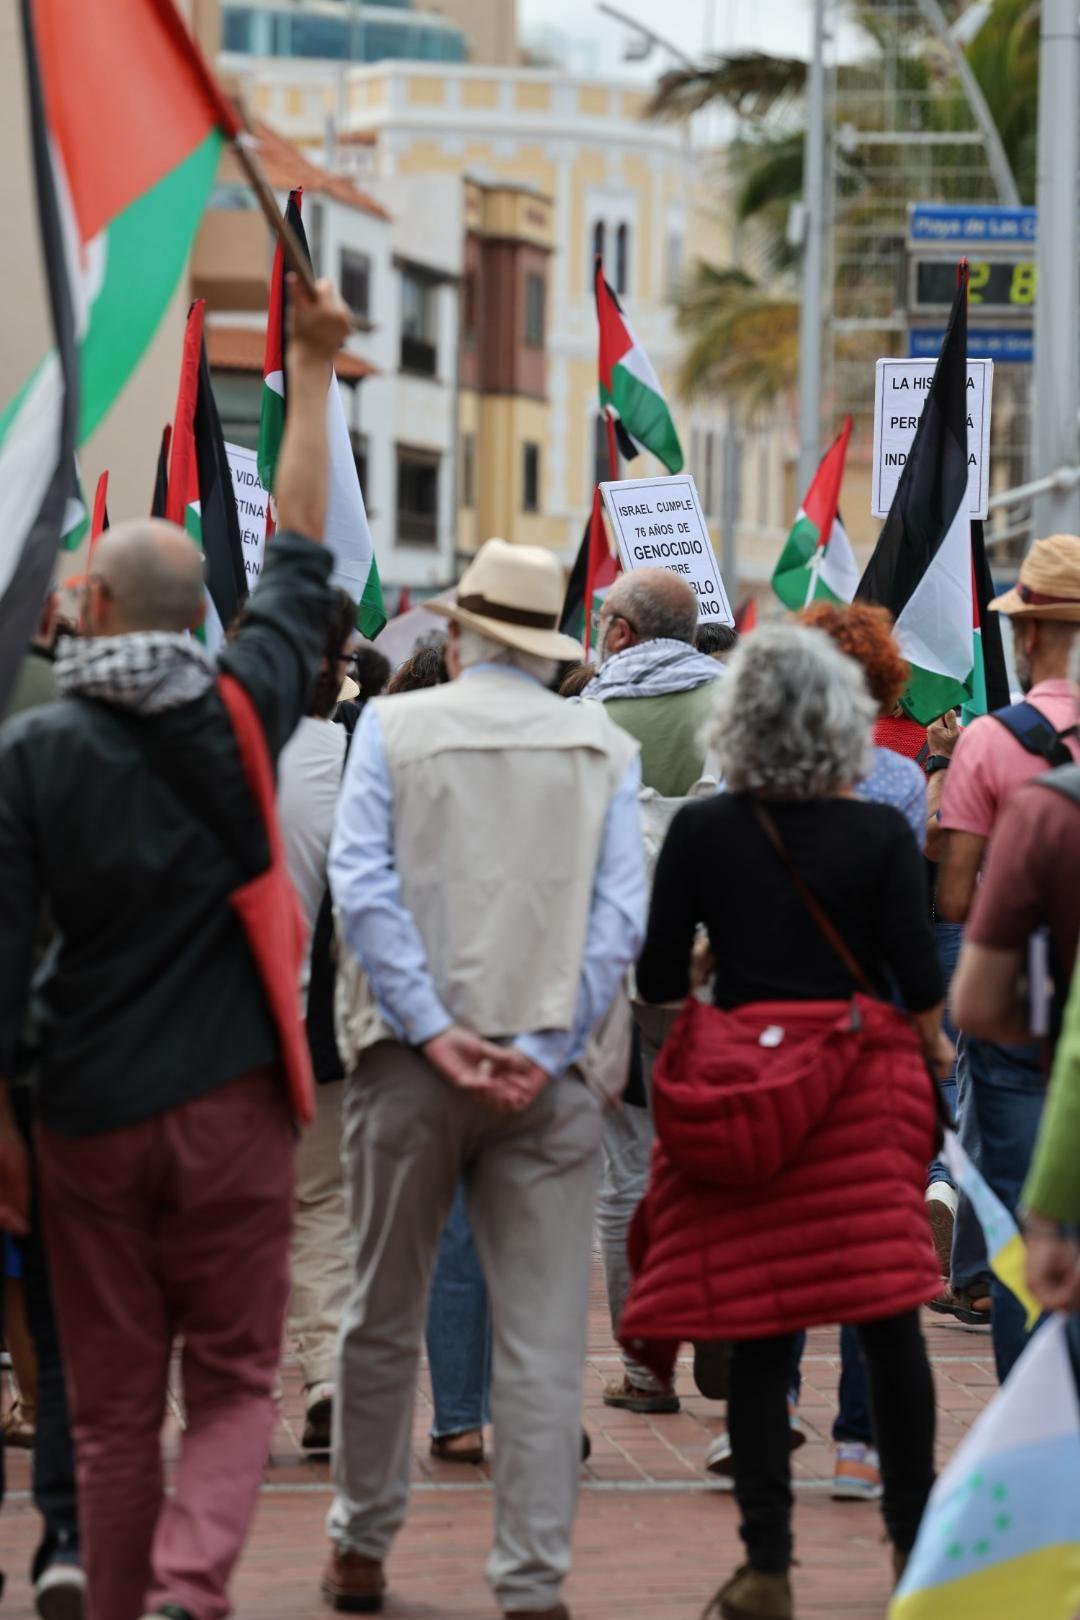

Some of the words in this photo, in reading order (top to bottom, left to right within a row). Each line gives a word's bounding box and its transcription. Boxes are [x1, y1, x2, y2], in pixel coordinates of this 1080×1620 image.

[892, 377, 909, 390] LA
[618, 503, 653, 517] ISRAEL
[656, 500, 693, 513] CUMPLE
[634, 527, 647, 538] 76
[648, 523, 674, 537] AÑOS
[677, 522, 690, 533] DE
[634, 540, 703, 560] GENOCIDIO
